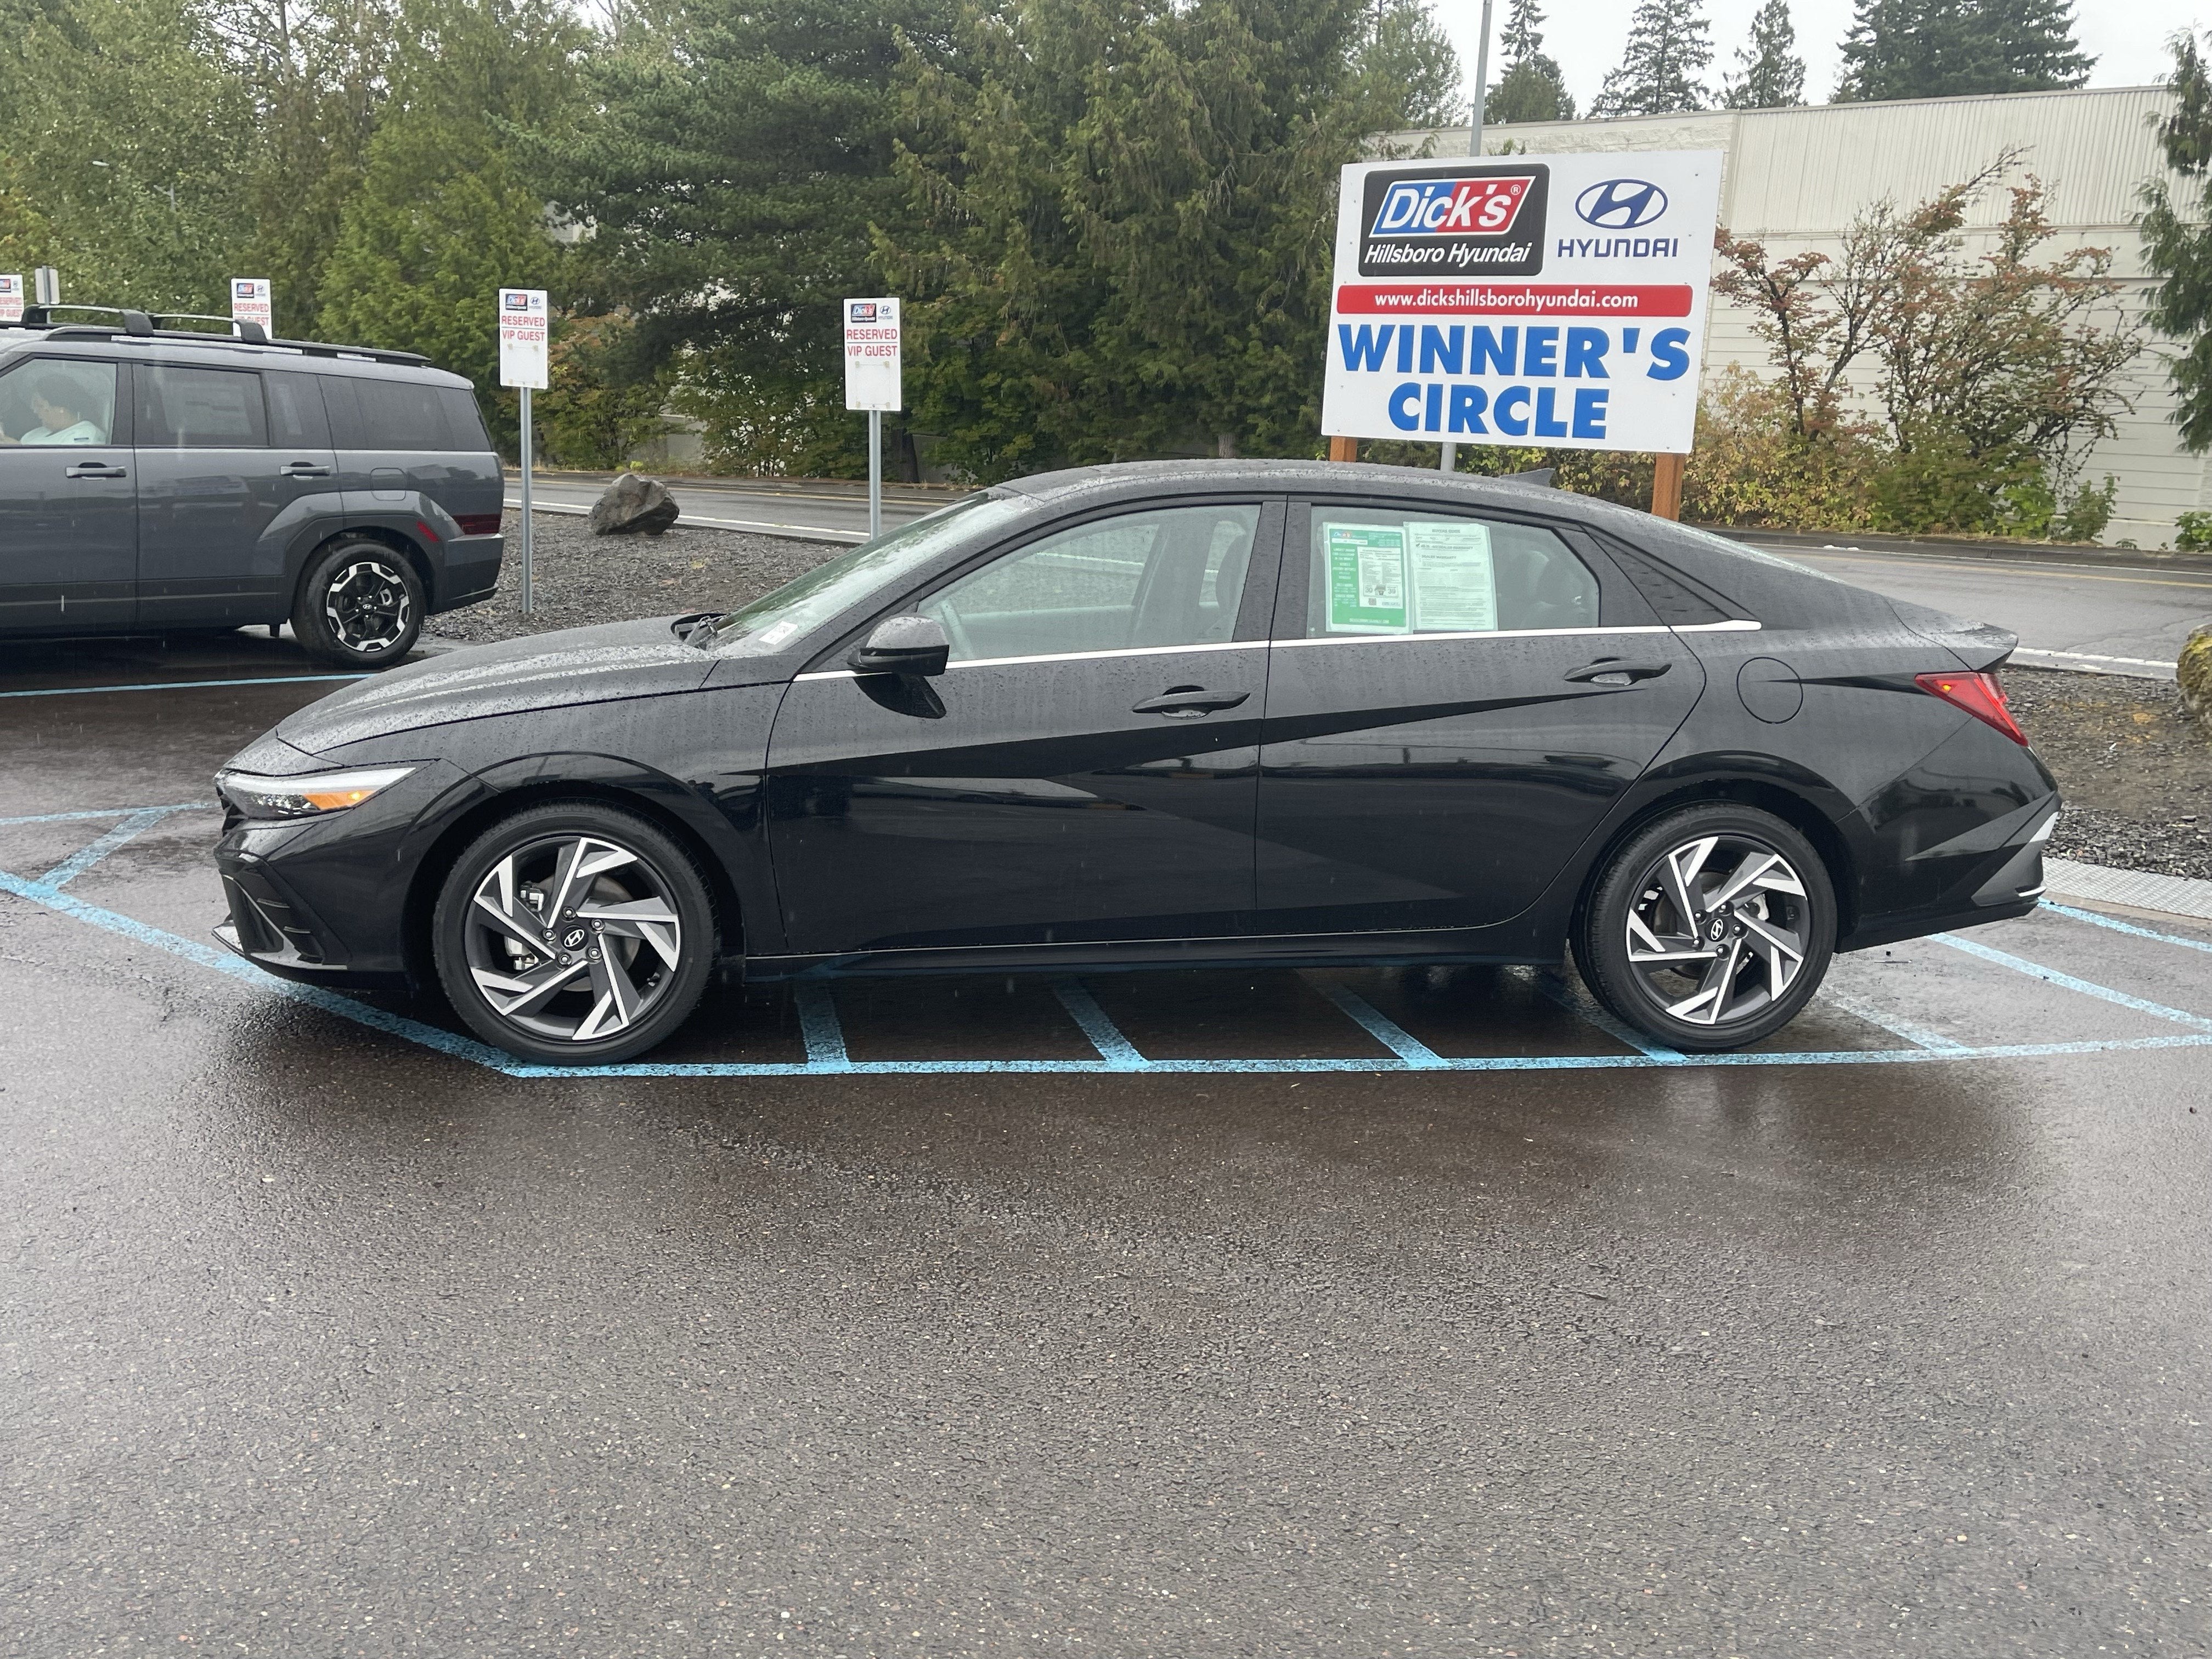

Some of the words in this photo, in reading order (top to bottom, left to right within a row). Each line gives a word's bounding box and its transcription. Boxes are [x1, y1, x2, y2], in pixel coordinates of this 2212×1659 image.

[1381, 184, 1511, 229] Dick's
[1364, 244, 1445, 263] Hillsboro
[1447, 242, 1533, 267] Hyundai
[1558, 238, 1679, 258] HYUNDAI
[0, 297, 21, 305] ESERVED
[234, 303, 269, 312] RESERVED
[1375, 289, 1638, 311] www.dickshillsborohyundai.com
[501, 315, 545, 326] RESERVED
[502, 330, 515, 339] VIP
[517, 331, 545, 341] GUEST
[847, 329, 898, 340] RESERVED
[848, 346, 862, 356] VIP
[865, 346, 898, 356] GUEST
[1338, 324, 1691, 381] WINNER'S
[1388, 382, 1610, 439] CIRCLE
